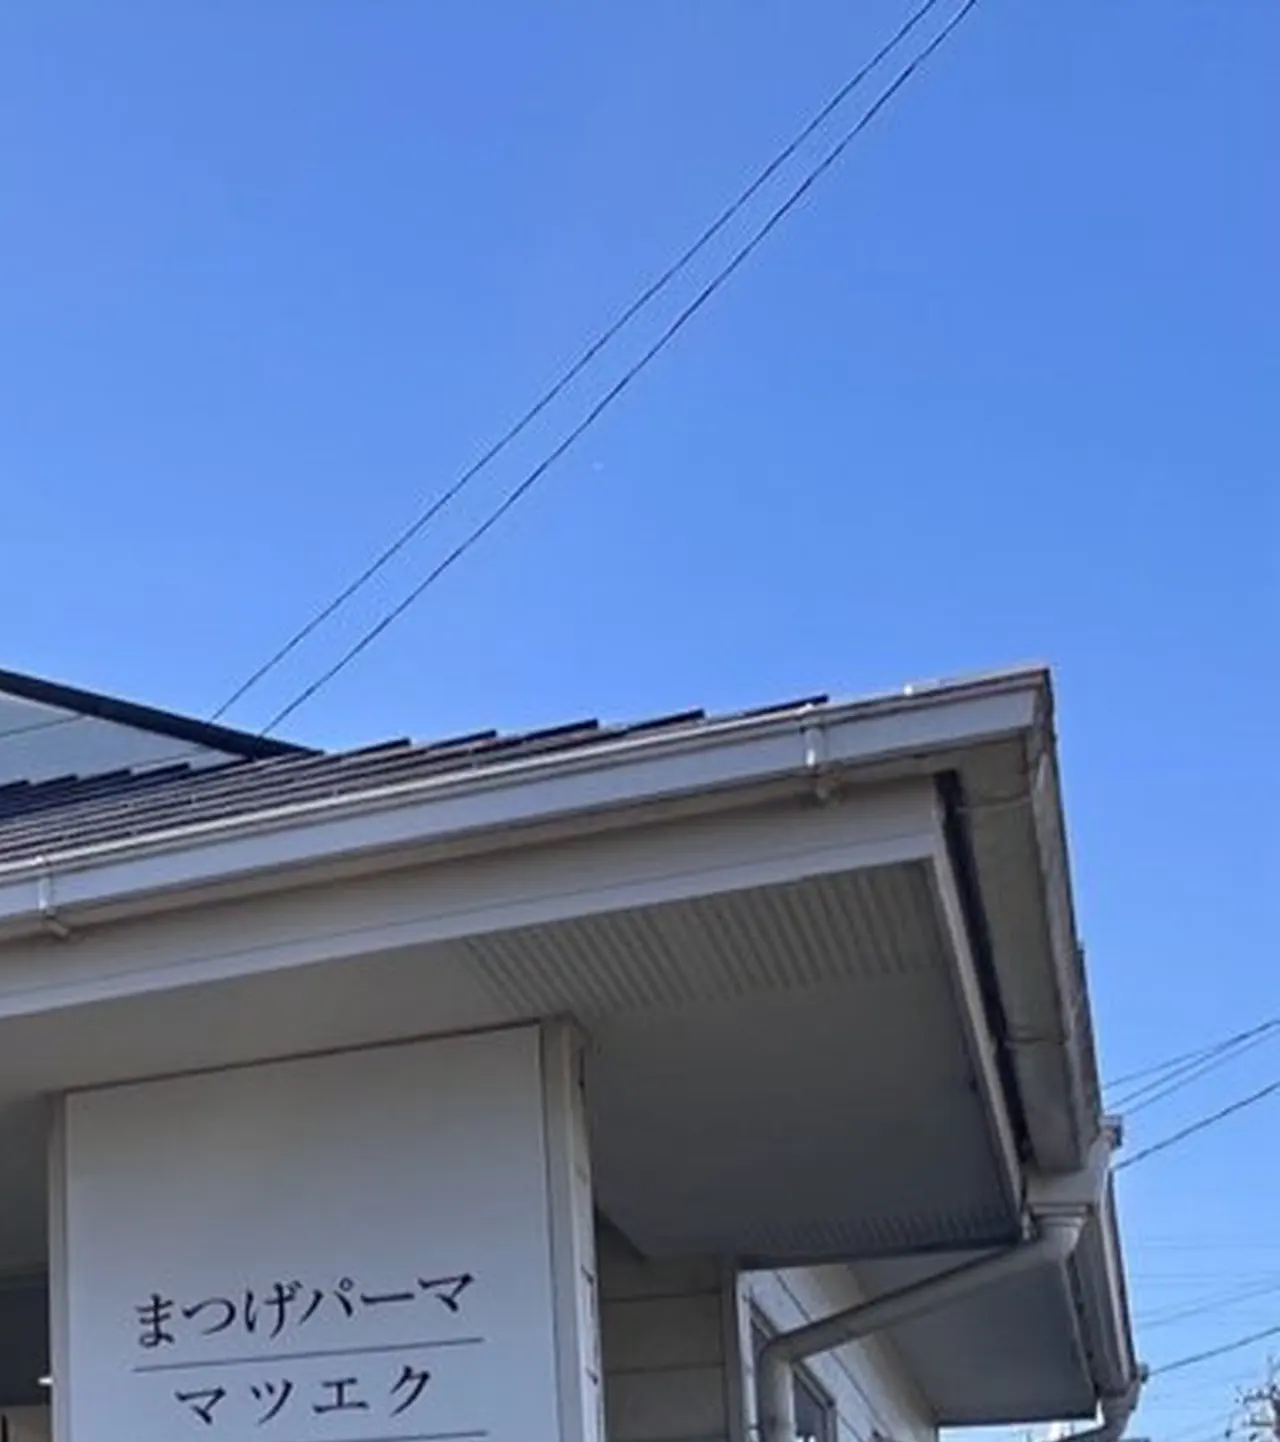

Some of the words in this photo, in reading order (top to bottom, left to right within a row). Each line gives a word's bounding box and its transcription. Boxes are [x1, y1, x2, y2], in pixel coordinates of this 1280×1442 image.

[134, 1270, 476, 1350] まつげパーマ
[173, 1363, 433, 1427] マツエク
